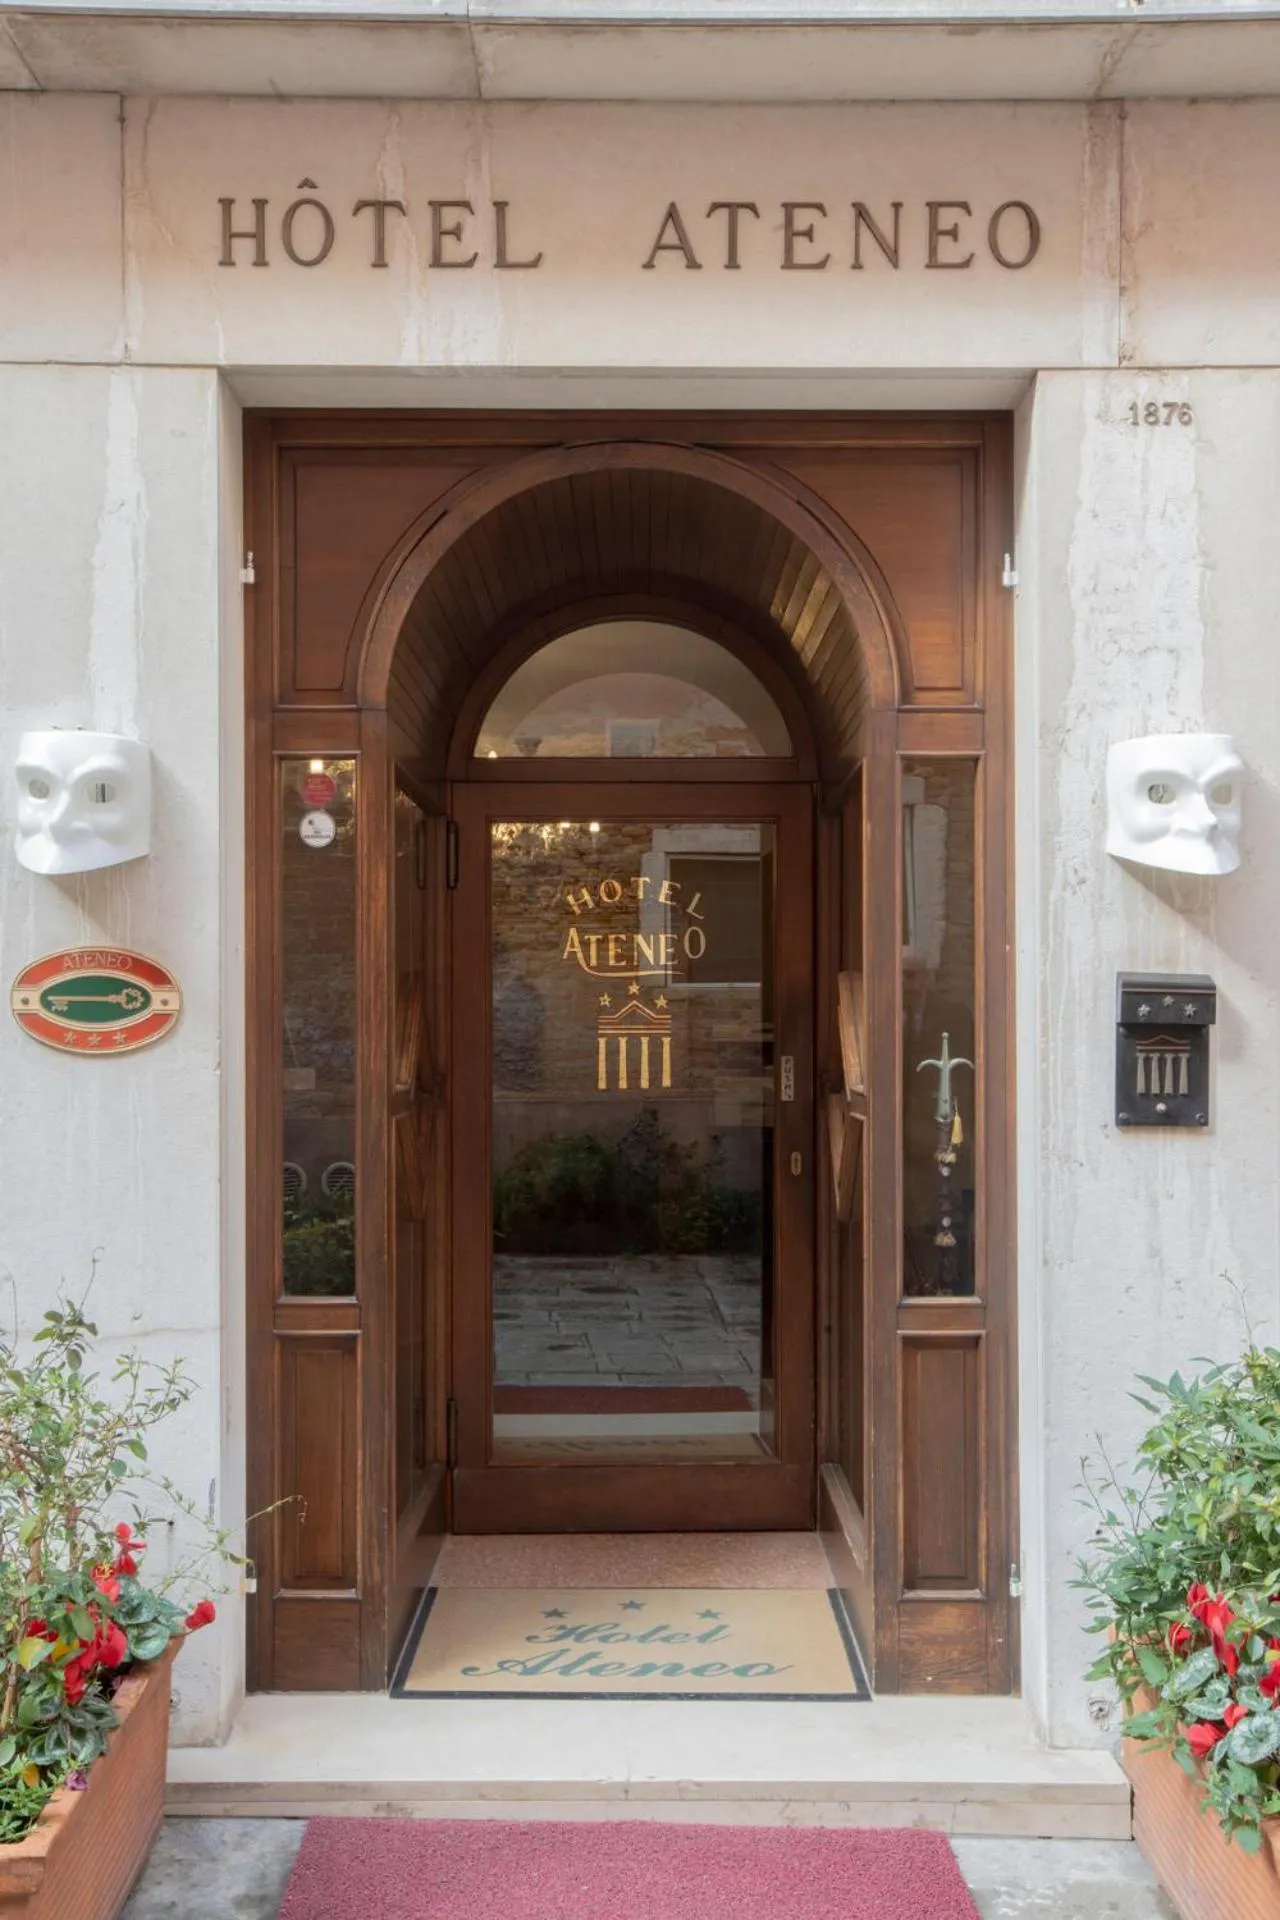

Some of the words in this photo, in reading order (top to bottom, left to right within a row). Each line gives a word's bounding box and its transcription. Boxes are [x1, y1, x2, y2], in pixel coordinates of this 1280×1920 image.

[218, 177, 543, 268] HÔTEL
[641, 200, 1042, 270] ATENEO
[1128, 402, 1193, 426] 1876
[566, 876, 705, 920] HOTEL
[63, 951, 133, 971] ATENEO
[562, 926, 706, 977] ATENEO
[525, 1622, 734, 1644] Hotel
[460, 1648, 794, 1678] Ateneo
